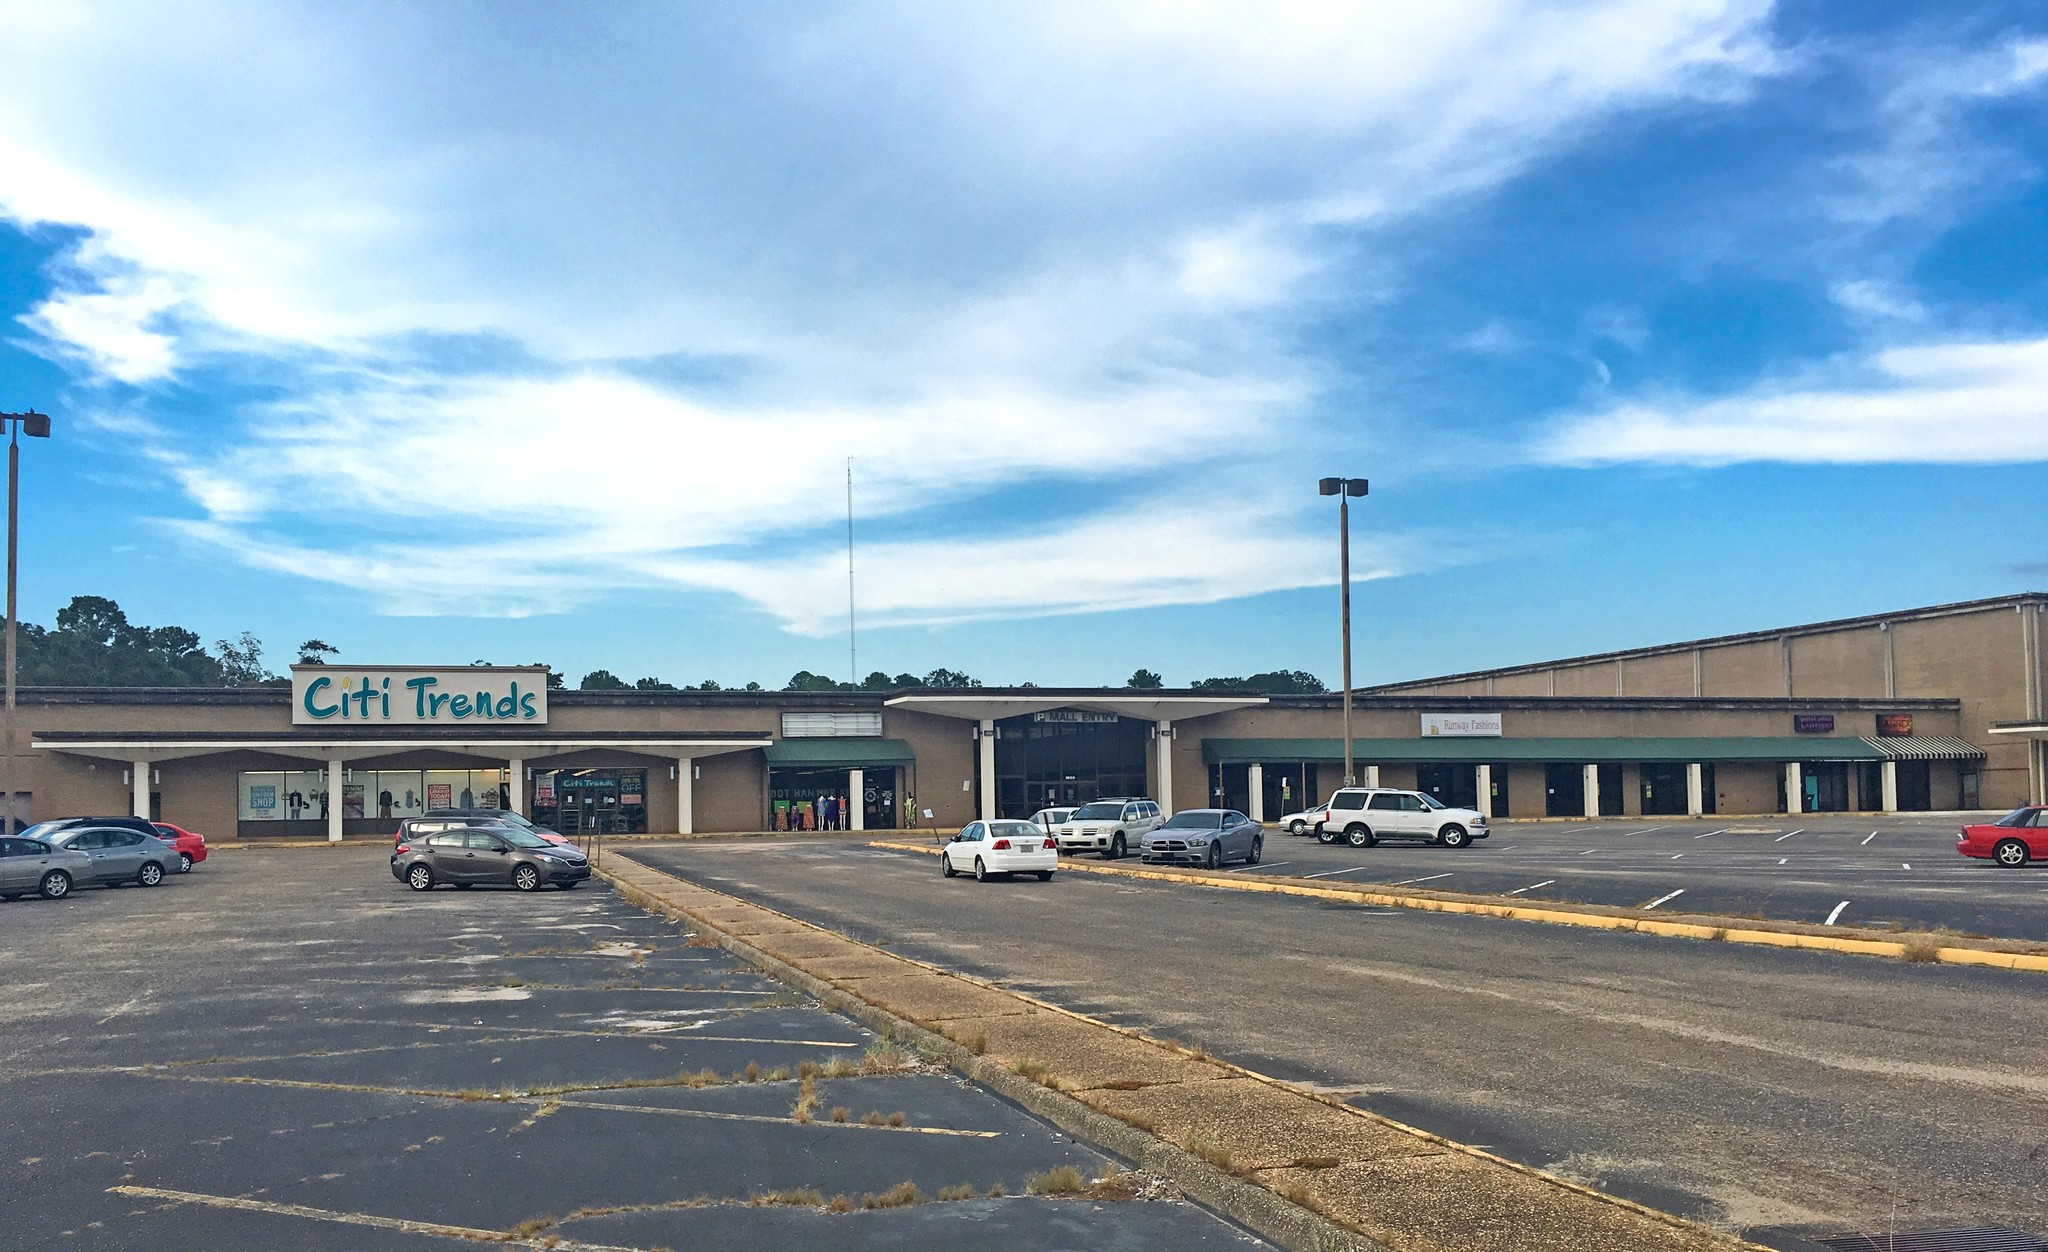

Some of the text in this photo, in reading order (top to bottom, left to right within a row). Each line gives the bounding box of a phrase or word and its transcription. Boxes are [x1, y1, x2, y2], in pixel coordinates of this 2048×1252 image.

[303, 676, 538, 719] Citi Trends
[1050, 711, 1078, 721] MALL
[1082, 712, 1115, 721] ENTRY
[1444, 720, 1499, 731] Runway Fashions
[563, 779, 583, 788] Citi
[584, 779, 615, 788] Trends
[621, 783, 641, 793] OFF
[251, 797, 275, 808] SHOP
